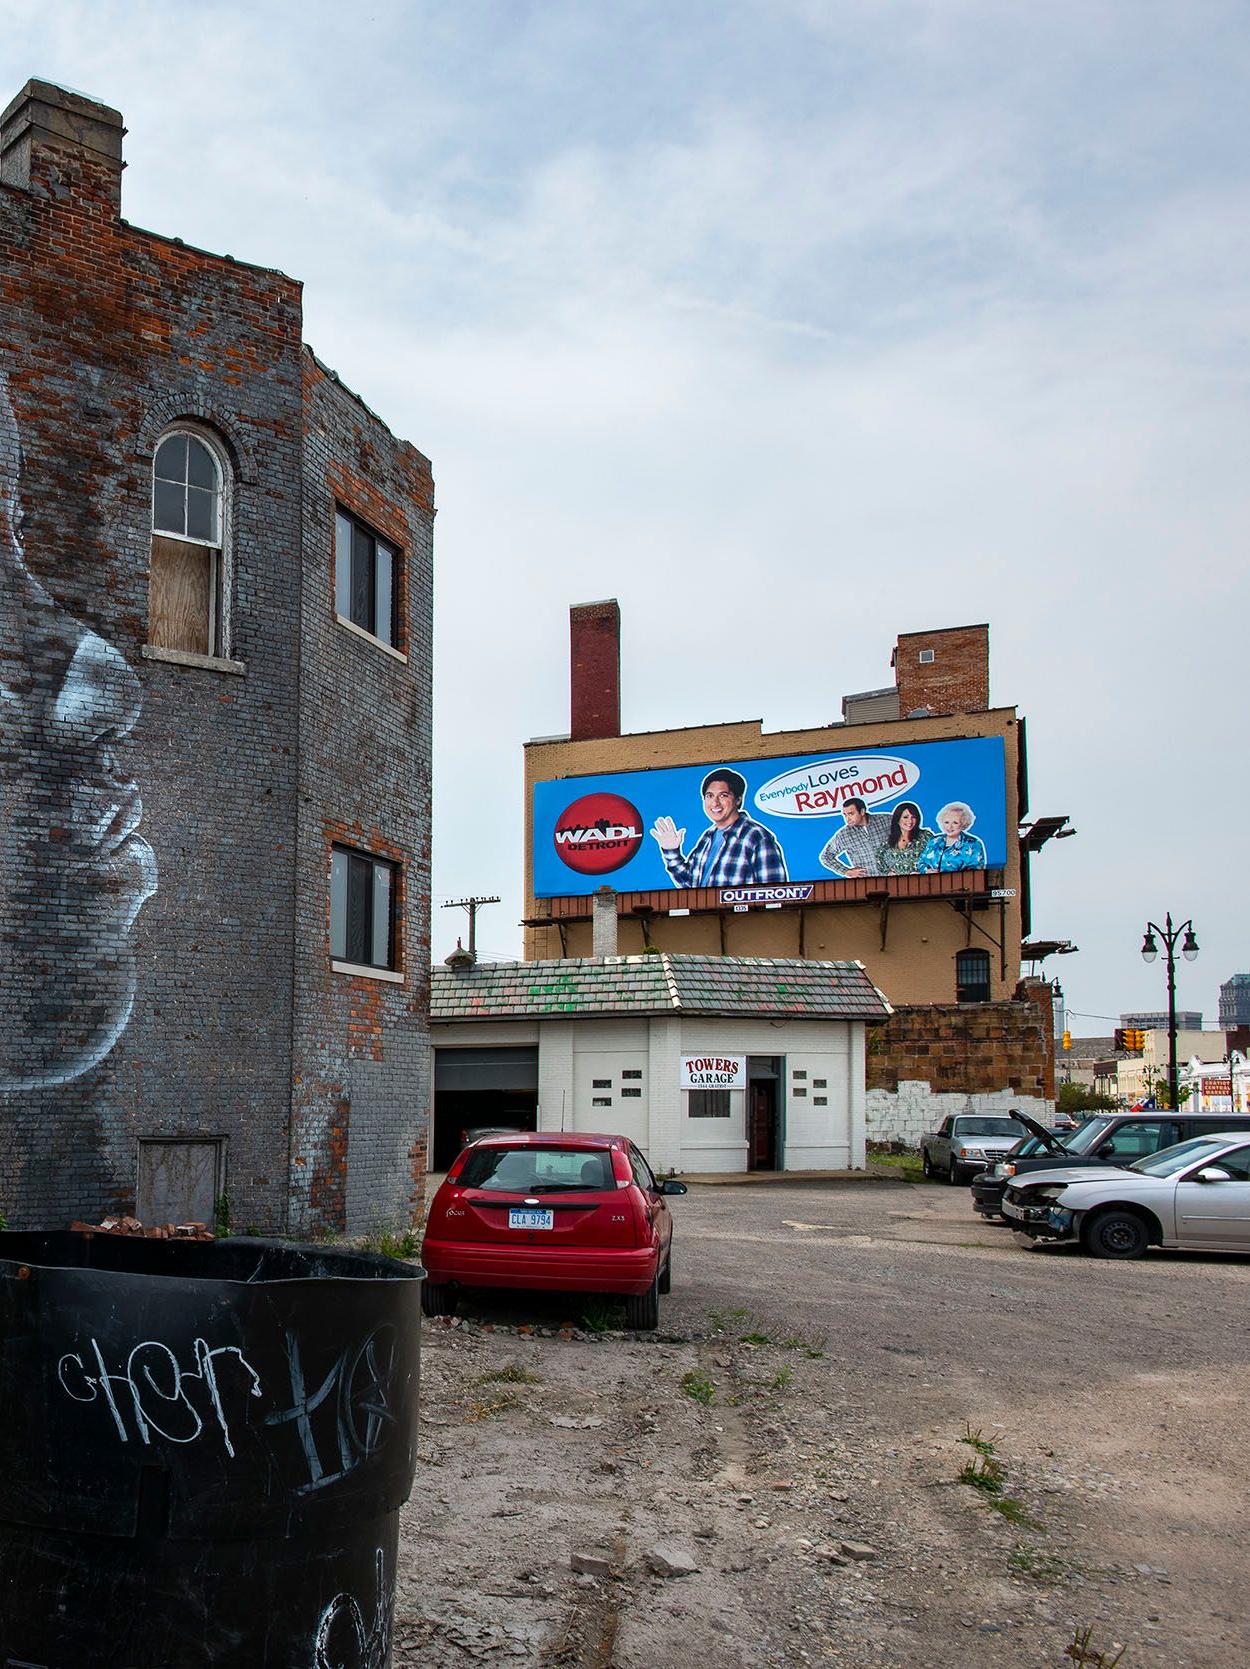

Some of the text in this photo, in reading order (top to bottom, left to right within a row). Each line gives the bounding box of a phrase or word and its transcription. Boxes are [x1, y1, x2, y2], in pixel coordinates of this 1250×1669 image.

[759, 765, 860, 801] Everybody Loves
[795, 764, 908, 812] Raymond
[555, 826, 643, 844] WADL
[568, 839, 630, 851] DETROIT
[723, 887, 808, 901] OUTFRONT
[685, 1058, 739, 1074] TOWERS
[690, 1073, 734, 1083] GARAGE
[511, 1214, 526, 1225] CLA
